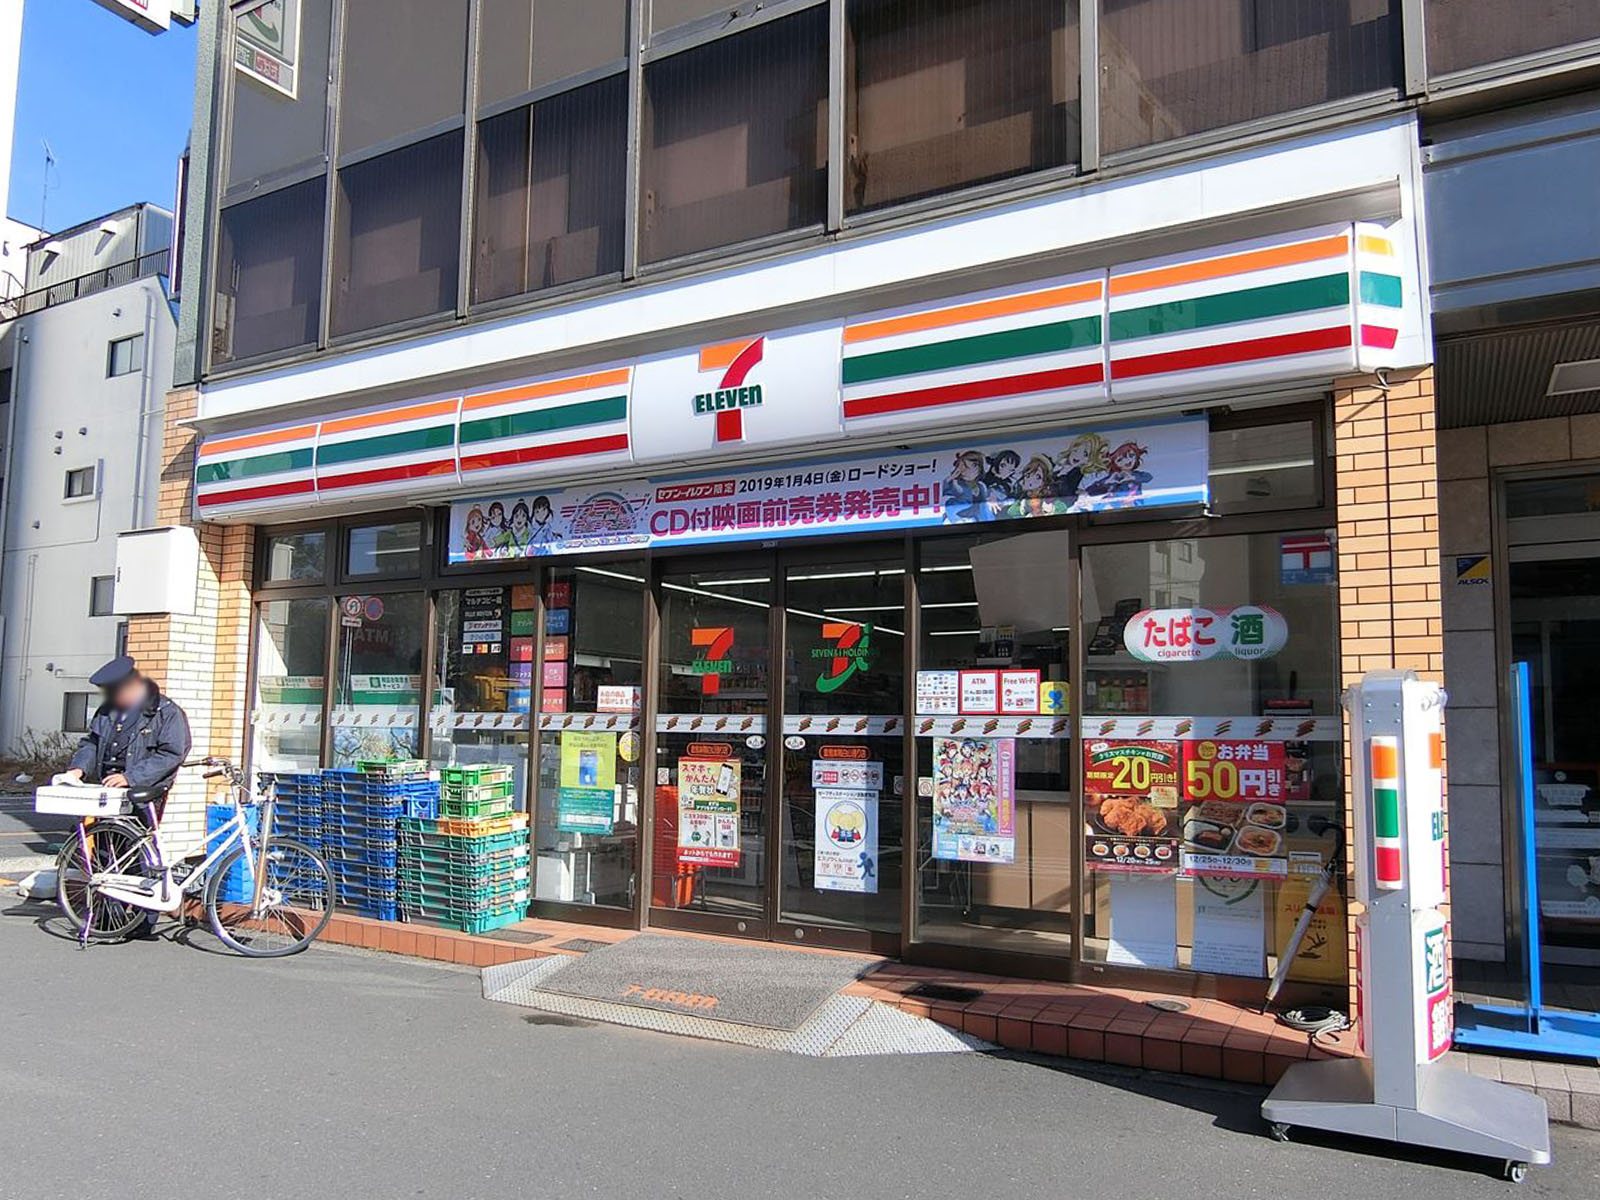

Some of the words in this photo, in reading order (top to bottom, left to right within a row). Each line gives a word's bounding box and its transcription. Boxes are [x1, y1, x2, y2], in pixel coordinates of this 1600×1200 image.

[650, 483, 941, 537] CD付映画前売券発売中!
[1144, 616, 1216, 647] たばこ
[1231, 613, 1263, 645] 酒
[1157, 648, 1201, 658] cigarette
[1234, 647, 1265, 658] liquor
[1003, 677, 1018, 685] Free
[1217, 743, 1270, 761] お弁当
[685, 774, 717, 784] かんたん
